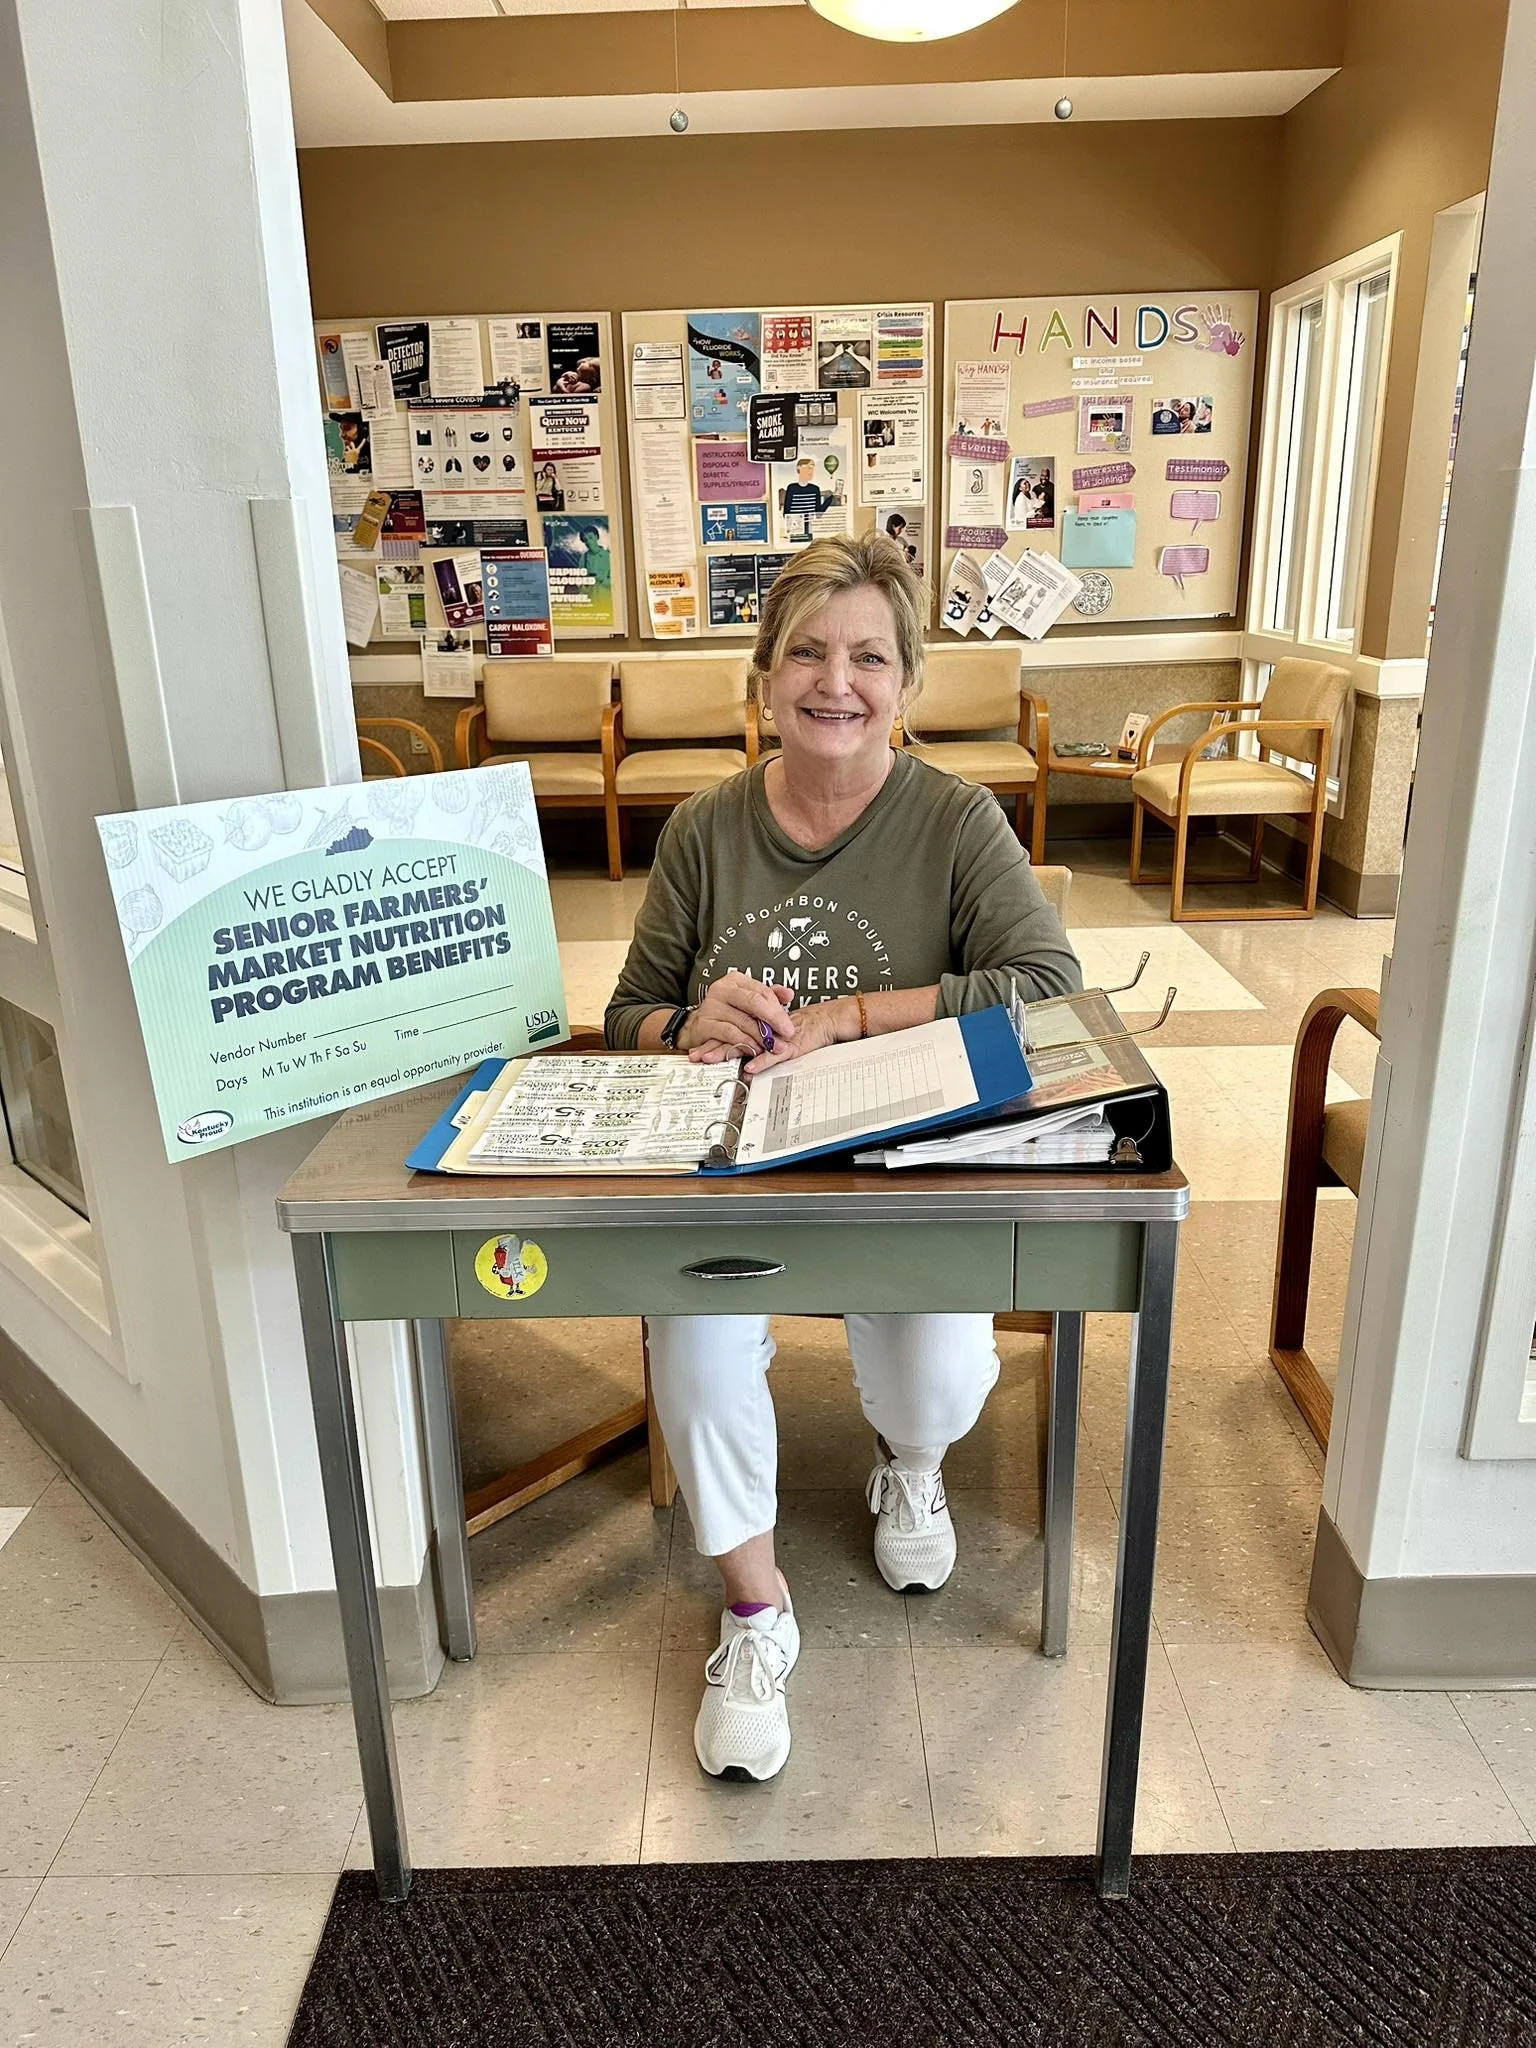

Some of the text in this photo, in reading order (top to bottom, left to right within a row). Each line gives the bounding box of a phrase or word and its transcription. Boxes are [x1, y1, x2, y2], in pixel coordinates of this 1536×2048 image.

[991, 305, 1199, 355] HANDS
[387, 341, 424, 361] DETECTOR
[391, 355, 424, 374] DE HUMO
[542, 417, 587, 426] QUIT NOW
[756, 414, 783, 430] SMOKE
[758, 425, 785, 440] ALARM
[960, 442, 997, 455] Events
[1080, 464, 1127, 477] Interested
[1169, 464, 1228, 475] Testimonials
[703, 480, 760, 488] SUPPLIES/SYRINGES
[958, 527, 994, 536] Product
[960, 535, 991, 544] Recalls
[550, 577, 596, 585] CLOUDED
[489, 623, 548, 632] CARRY NALOXONE.
[243, 854, 457, 912] WE GLADLY ACCEPT
[212, 877, 488, 955] SENIOR FARMERS'
[702, 895, 893, 978] PARIS-BOURBON COUNTY
[207, 904, 507, 991] MARKET NUTRITION
[210, 931, 512, 1025] PROGRAM BENEFITS
[525, 1008, 559, 1029] USDA
[209, 1031, 308, 1066] Vendor Number
[215, 1028, 420, 1093] Days M Tu W Th F Sa Su Time
[581, 1059, 609, 1068] $5
[264, 1107, 286, 1122] This
[288, 1091, 340, 1113] institution
[341, 1085, 351, 1097] is
[353, 1083, 368, 1095] an
[370, 1069, 402, 1092] equal
[403, 1054, 461, 1081] opportunity
[463, 1041, 505, 1064] provider.
[568, 1083, 597, 1093] $5
[555, 1106, 641, 1120] 2025 $5
[191, 1119, 229, 1138] Kentucky
[199, 1128, 223, 1142] Proud
[539, 1134, 630, 1148] 2025 $5
